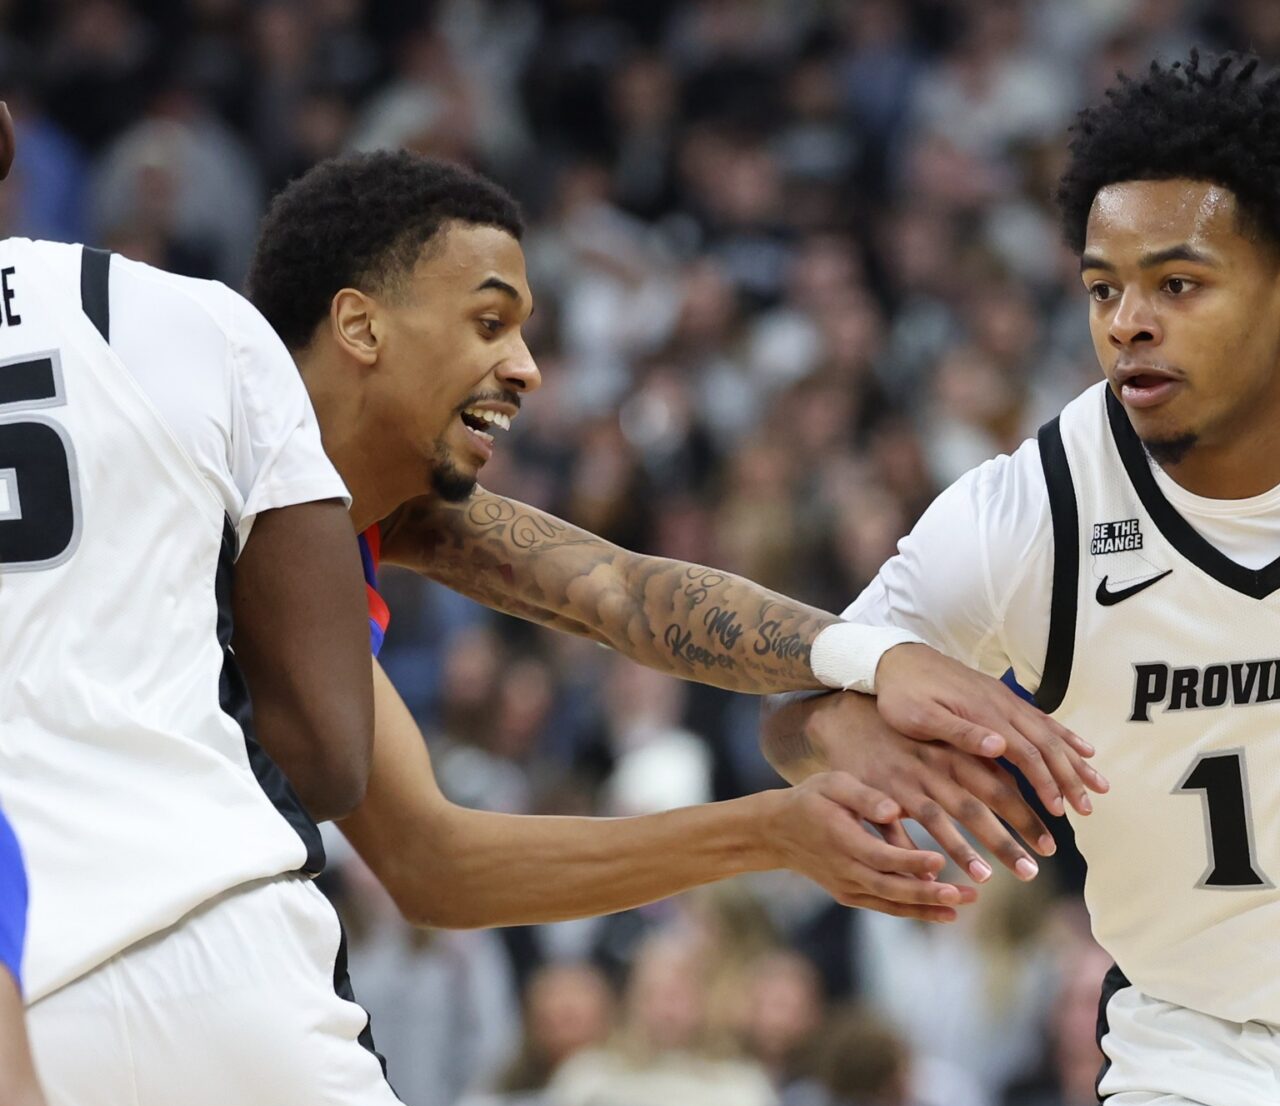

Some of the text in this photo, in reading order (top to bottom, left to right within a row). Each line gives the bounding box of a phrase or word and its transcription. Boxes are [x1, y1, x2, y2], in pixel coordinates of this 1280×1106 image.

[1091, 534, 1142, 554] CHANGE
[1093, 520, 1138, 539] BE THE
[703, 606, 744, 650] My
[664, 623, 737, 670] Keeper
